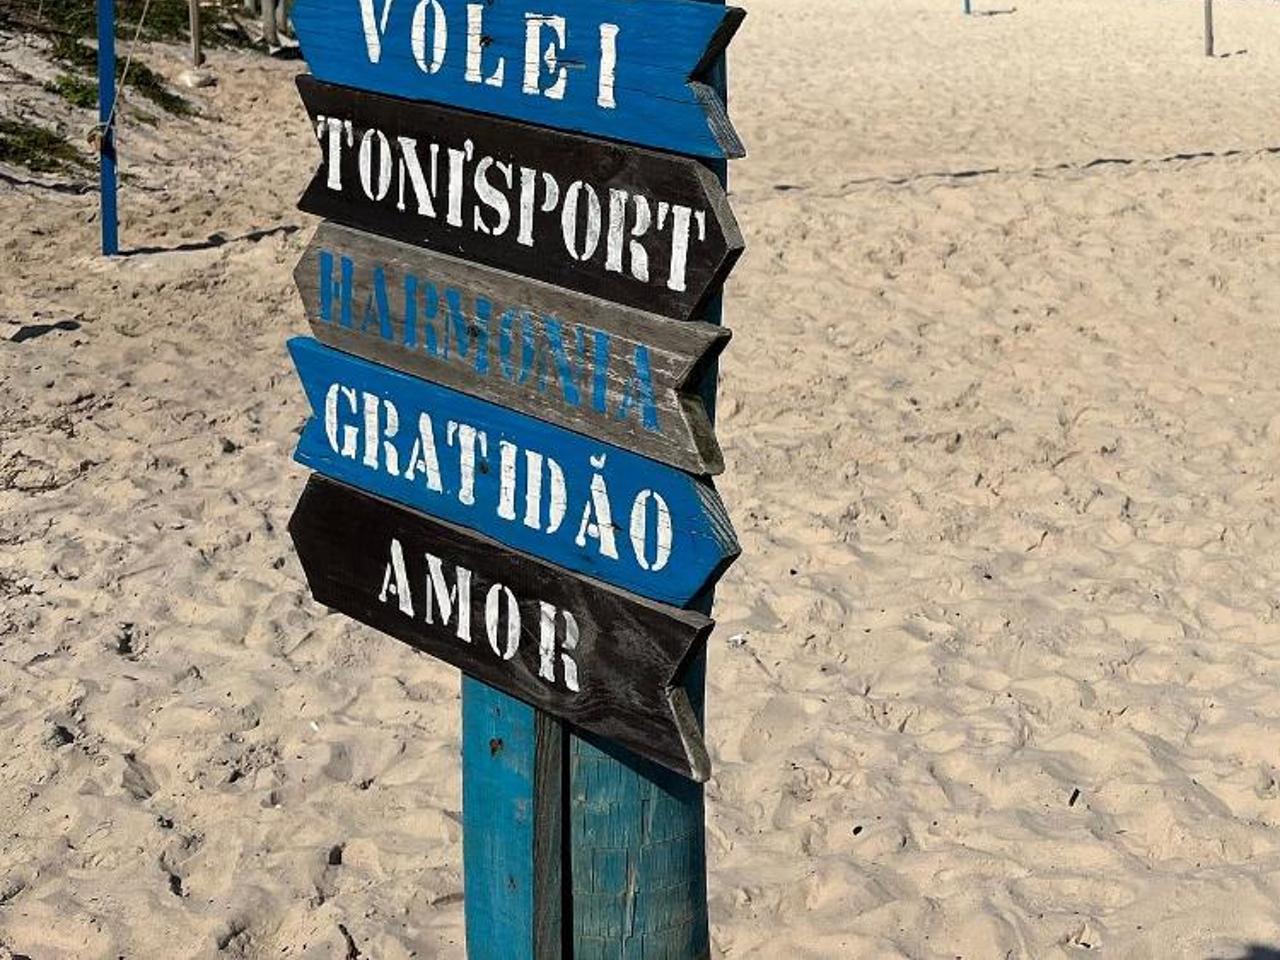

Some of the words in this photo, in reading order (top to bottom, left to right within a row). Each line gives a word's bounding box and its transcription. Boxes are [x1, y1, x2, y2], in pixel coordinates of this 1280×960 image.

[316, 114, 706, 293] TONI'SPORT
[316, 247, 662, 434] HARMONIA
[324, 381, 674, 573] GRATIDÃO
[378, 537, 580, 693] AMOR
